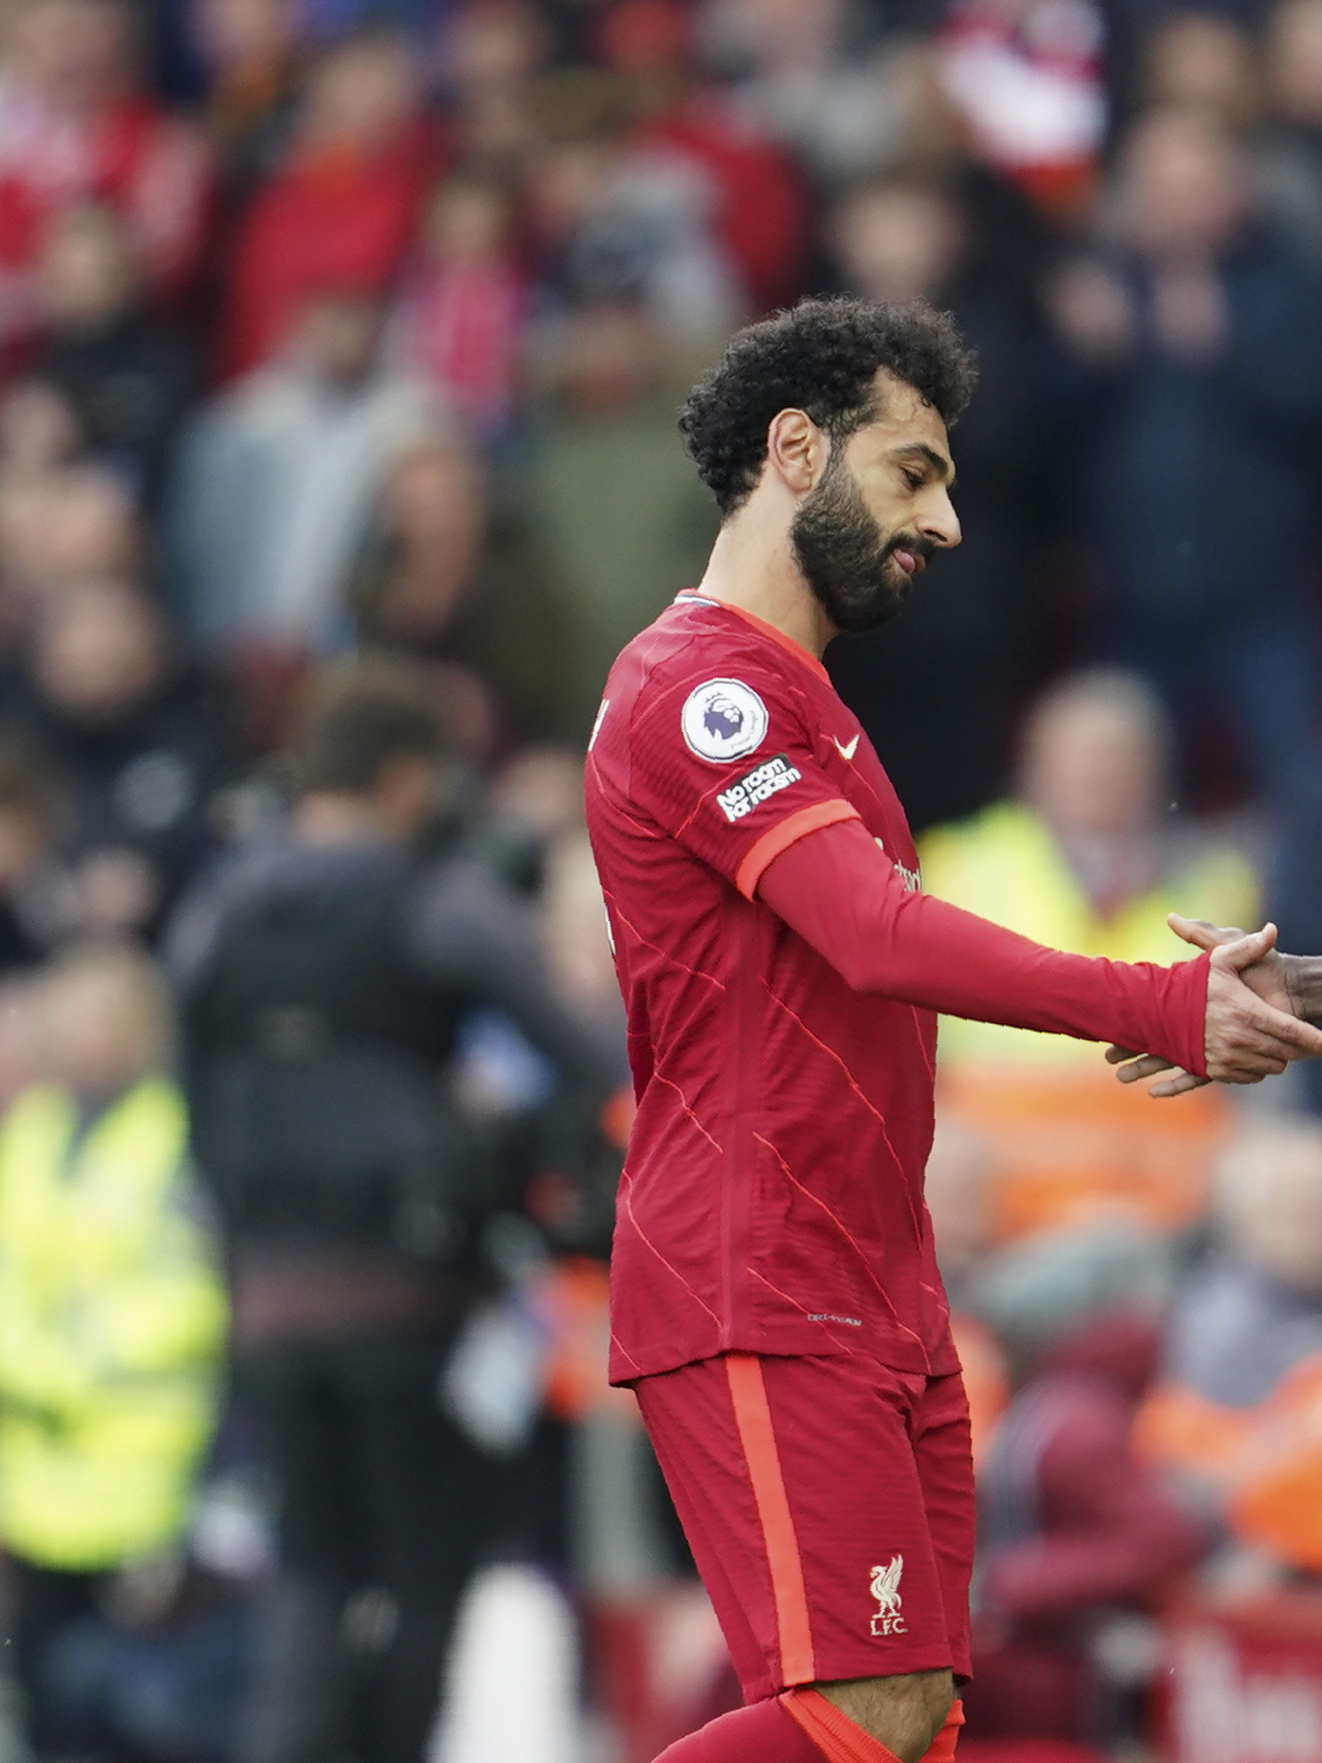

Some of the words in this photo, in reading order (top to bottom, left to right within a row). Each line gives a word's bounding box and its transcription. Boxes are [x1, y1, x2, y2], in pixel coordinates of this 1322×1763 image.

[716, 785, 746, 805] No
[742, 758, 788, 793] room
[722, 796, 752, 822] for
